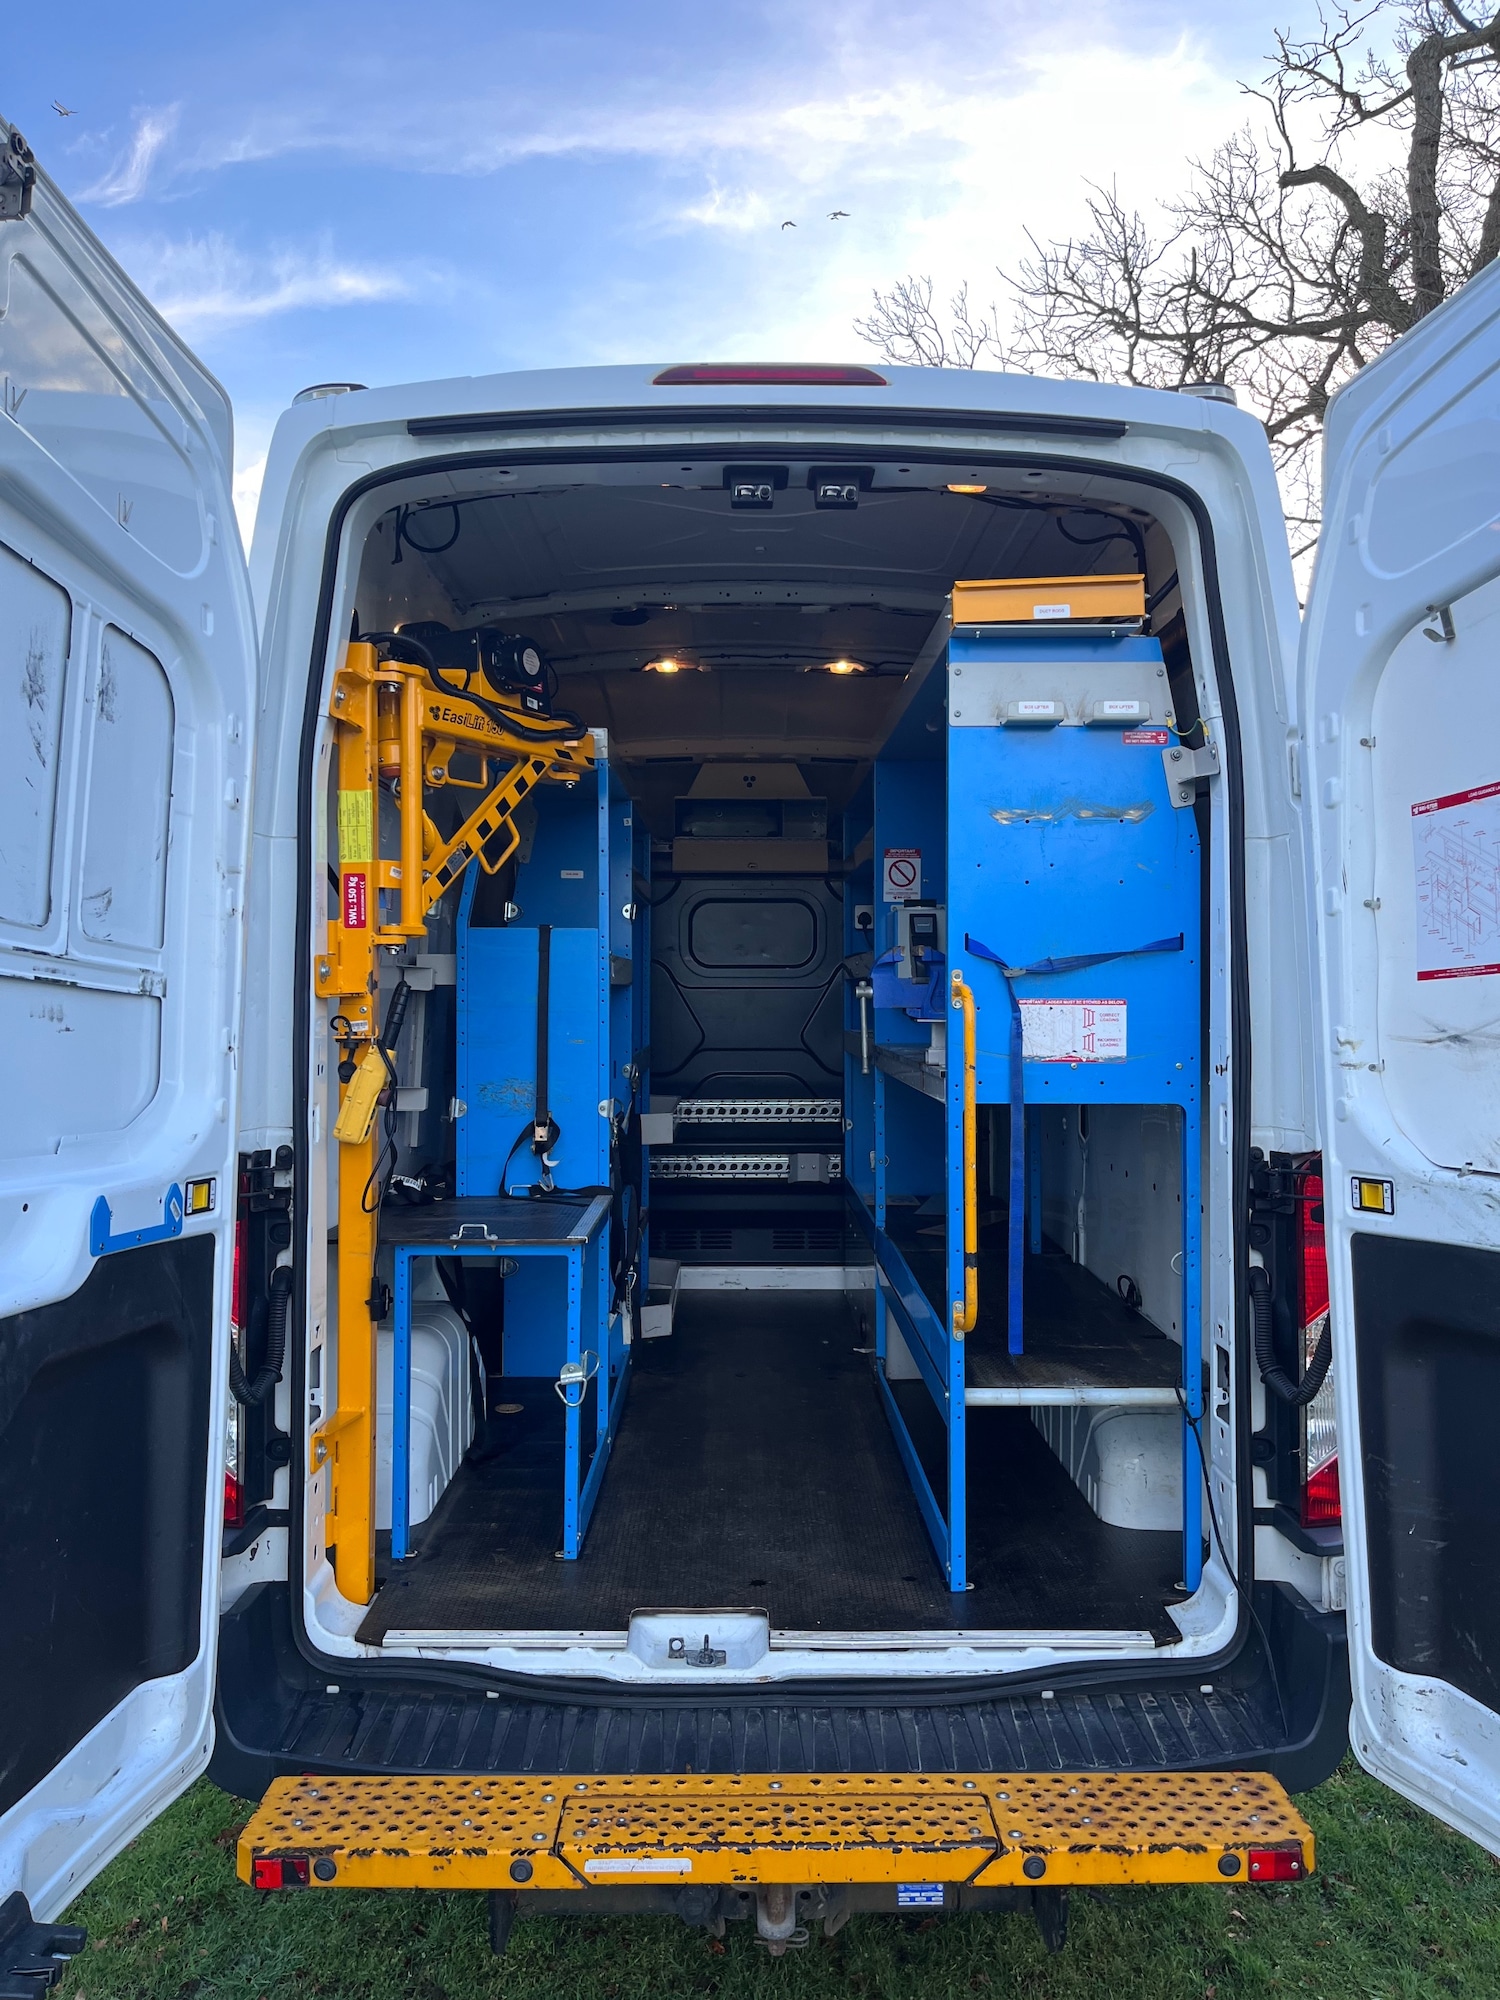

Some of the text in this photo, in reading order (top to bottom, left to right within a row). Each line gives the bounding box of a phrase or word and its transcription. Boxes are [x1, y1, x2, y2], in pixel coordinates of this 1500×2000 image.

[442, 707, 485, 731] EasiLift
[348, 876, 359, 926] SWL: 150 Kg
